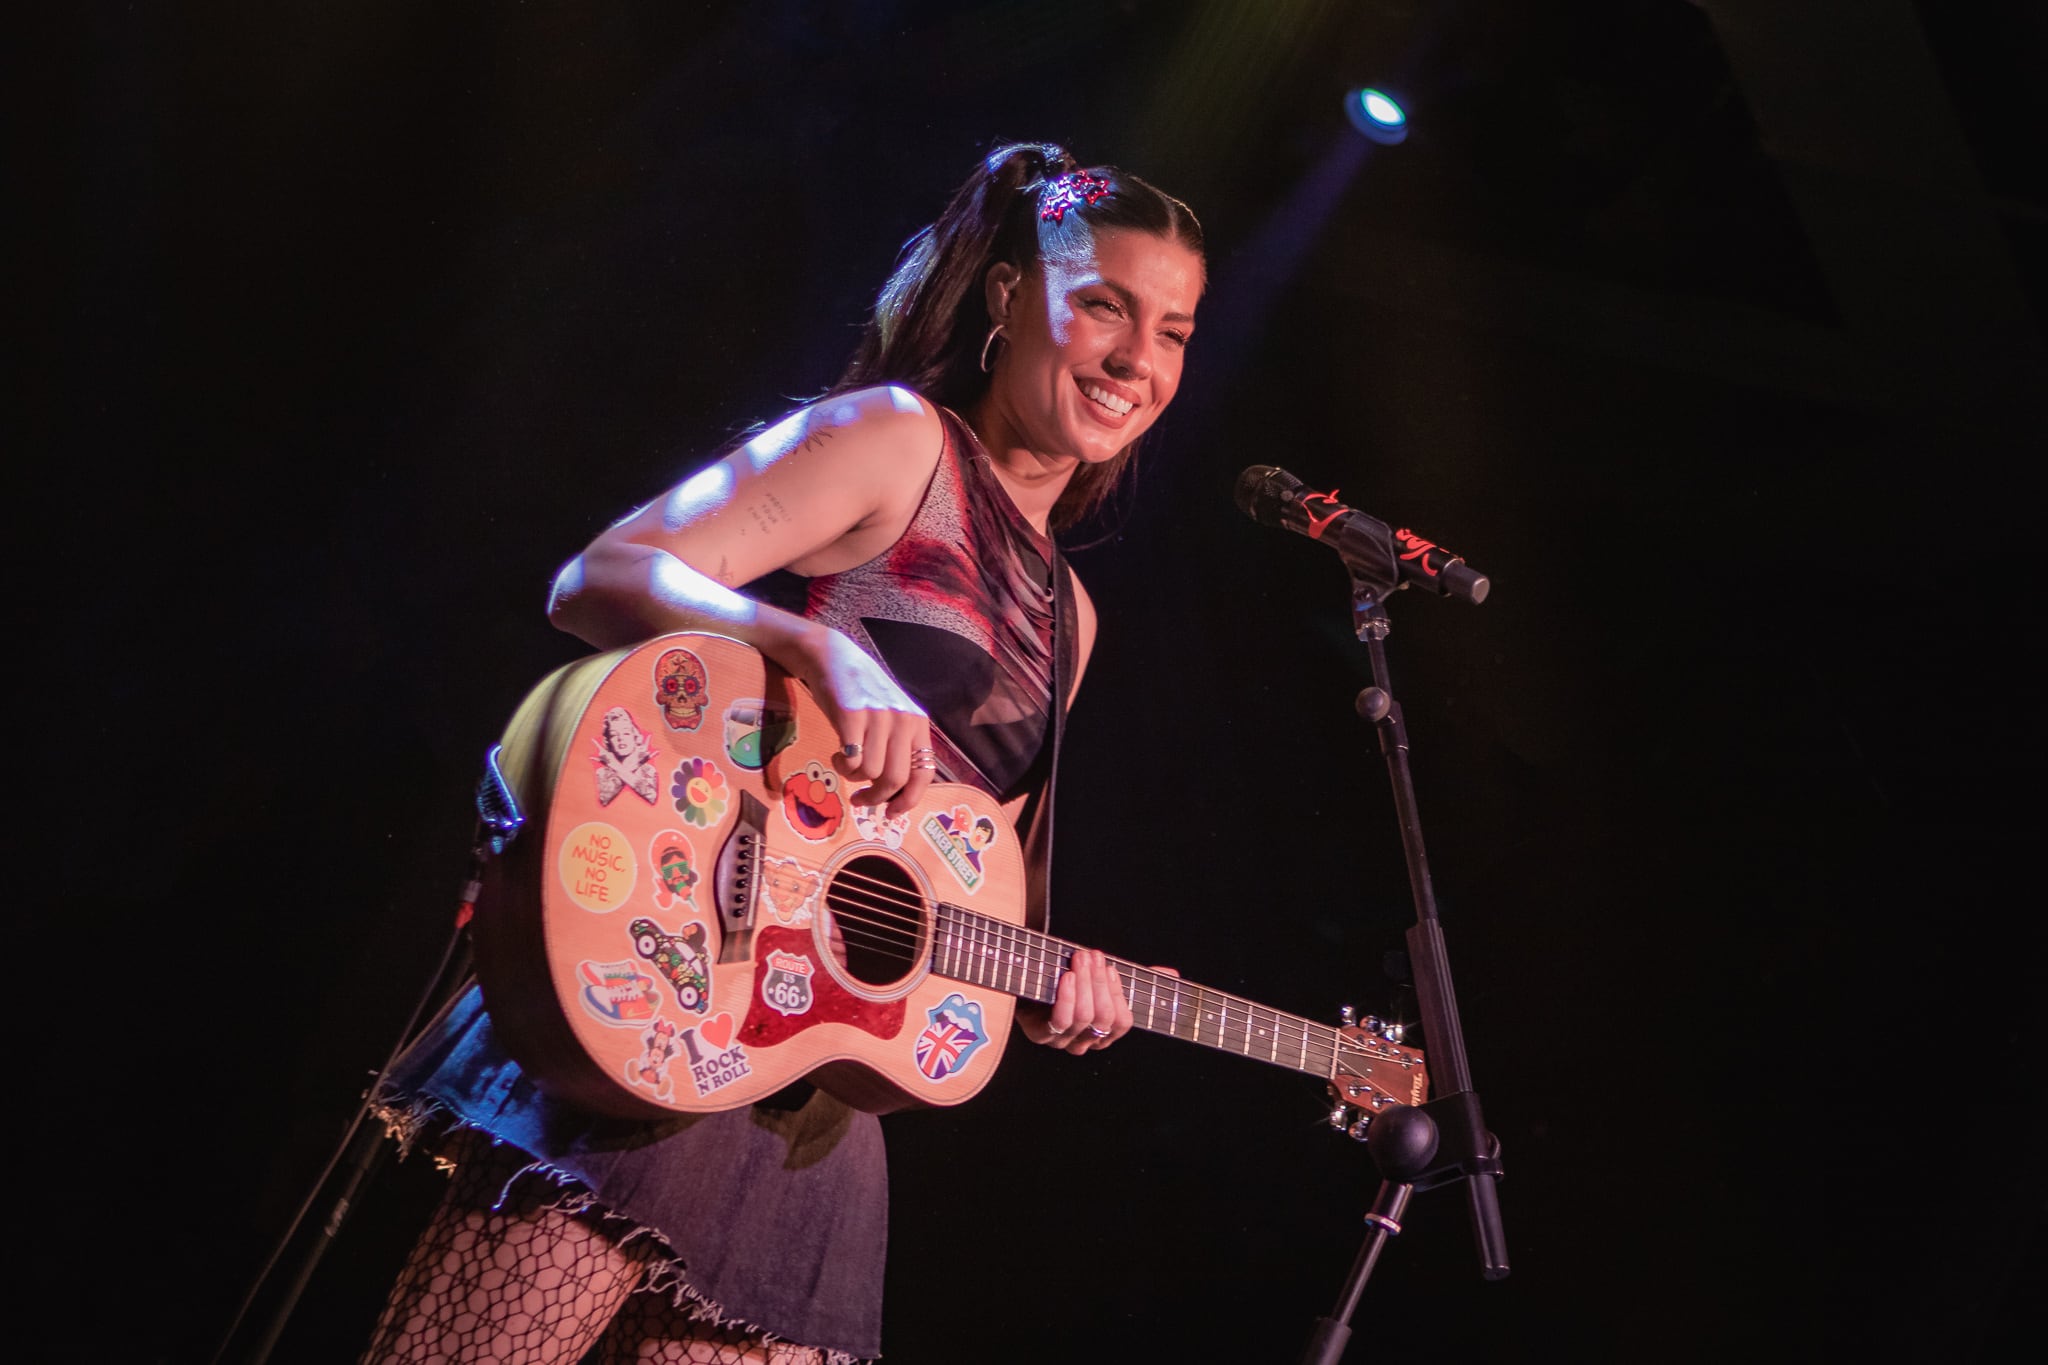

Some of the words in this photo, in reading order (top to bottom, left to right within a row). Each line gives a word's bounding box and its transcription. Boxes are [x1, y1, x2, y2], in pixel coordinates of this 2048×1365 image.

[590, 834, 611, 850] NO
[924, 818, 955, 856] BAKER
[946, 847, 979, 886] STREET
[585, 867, 607, 882] NO
[773, 957, 807, 973] ROUTE
[783, 973, 796, 984] US
[775, 982, 800, 1008] 66
[680, 1029, 704, 1066] I
[692, 1045, 747, 1082] ROCK
[711, 1062, 751, 1089] ROLL
[1410, 1072, 1423, 1108] Taylo
